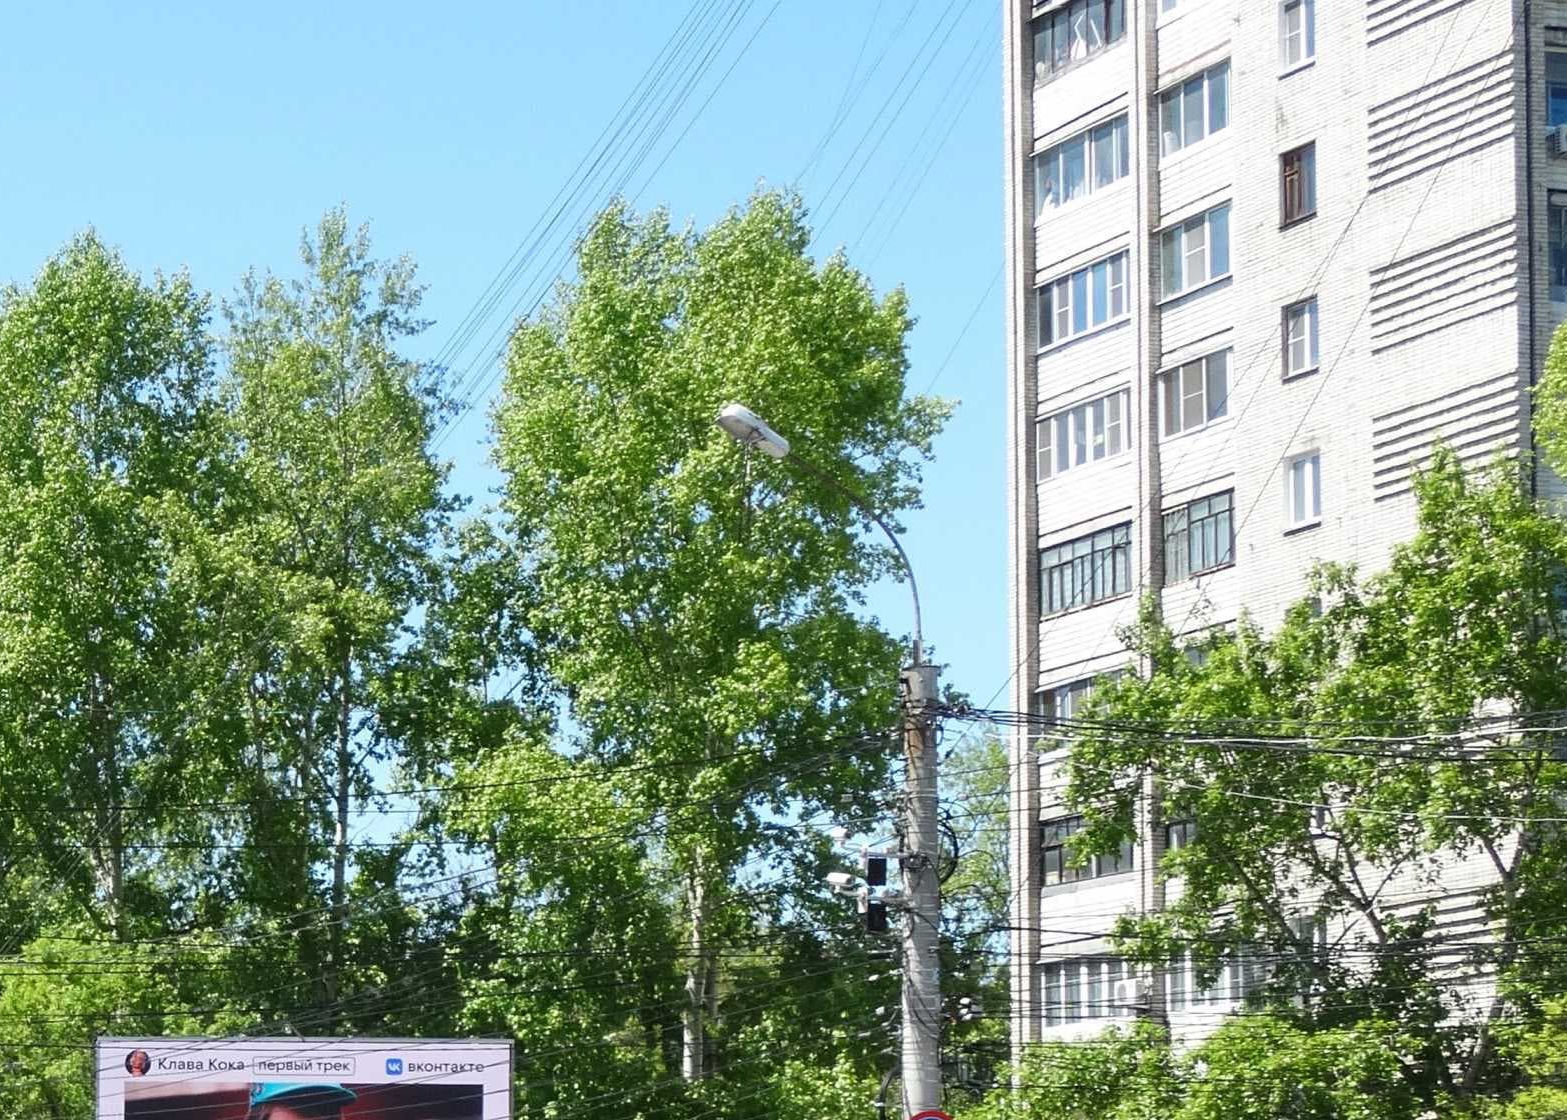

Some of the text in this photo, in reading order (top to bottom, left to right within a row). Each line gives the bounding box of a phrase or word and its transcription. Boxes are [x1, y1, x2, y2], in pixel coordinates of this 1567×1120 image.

[158, 1058, 245, 1071] Клава Кока
[258, 1059, 350, 1072] первый трек
[408, 1062, 485, 1073] вконтакте
